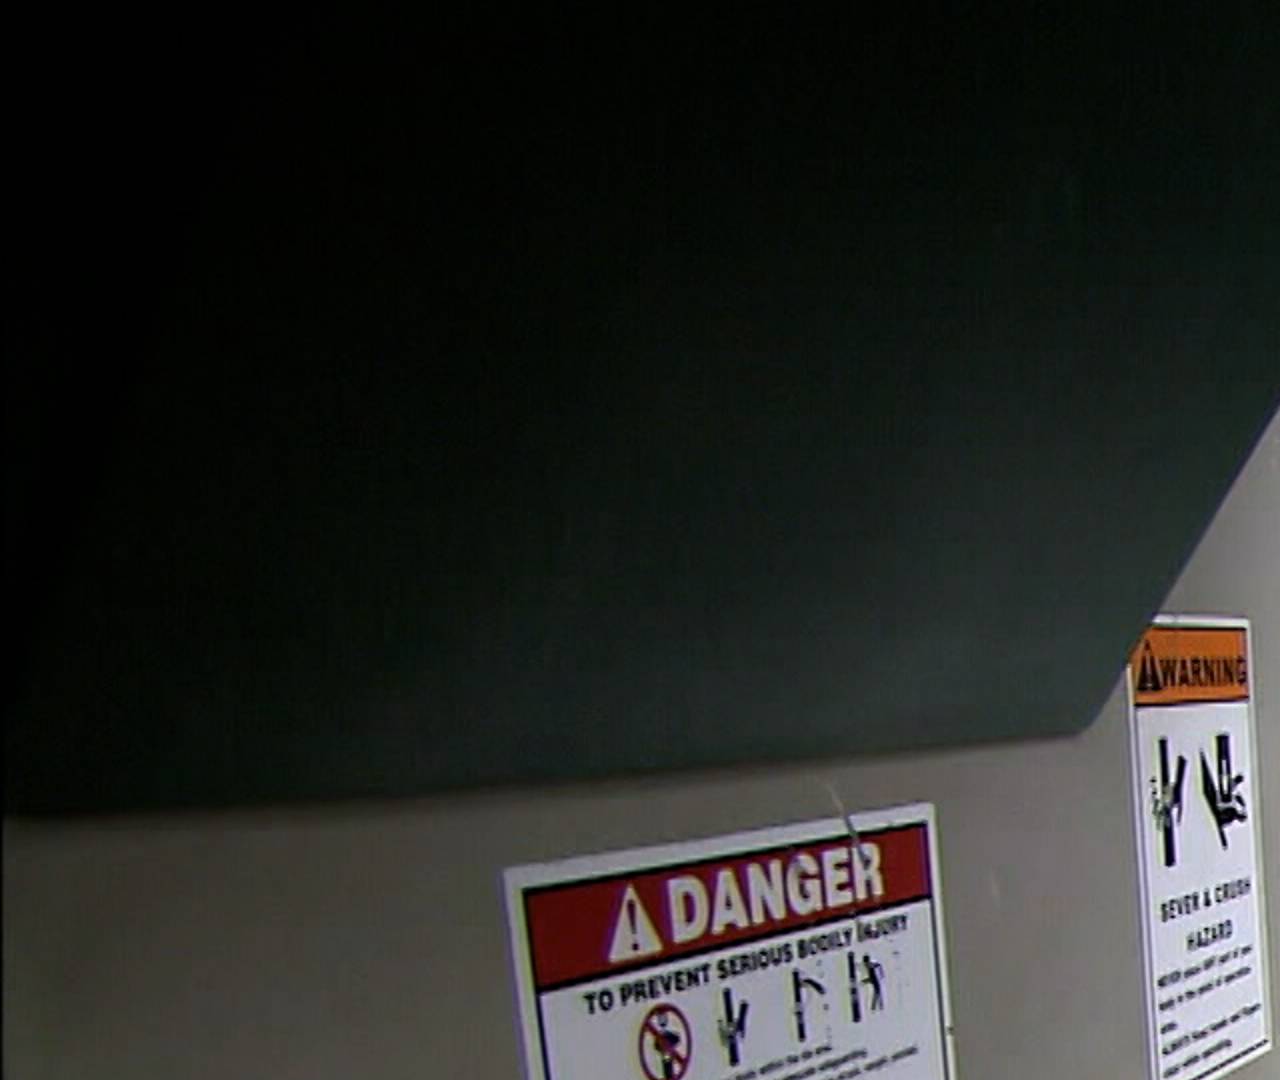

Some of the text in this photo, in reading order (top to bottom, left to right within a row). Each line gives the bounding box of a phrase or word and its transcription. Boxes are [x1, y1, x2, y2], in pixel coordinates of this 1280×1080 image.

[1160, 656, 1247, 687] WARNING
[668, 842, 884, 944] DANGER
[1160, 878, 1252, 923] SEVER & CRUSH
[1186, 919, 1233, 951] HAZARD
[582, 988, 615, 1015] TO
[618, 962, 710, 1007] PREVENT
[715, 942, 794, 981] SERIOUS
